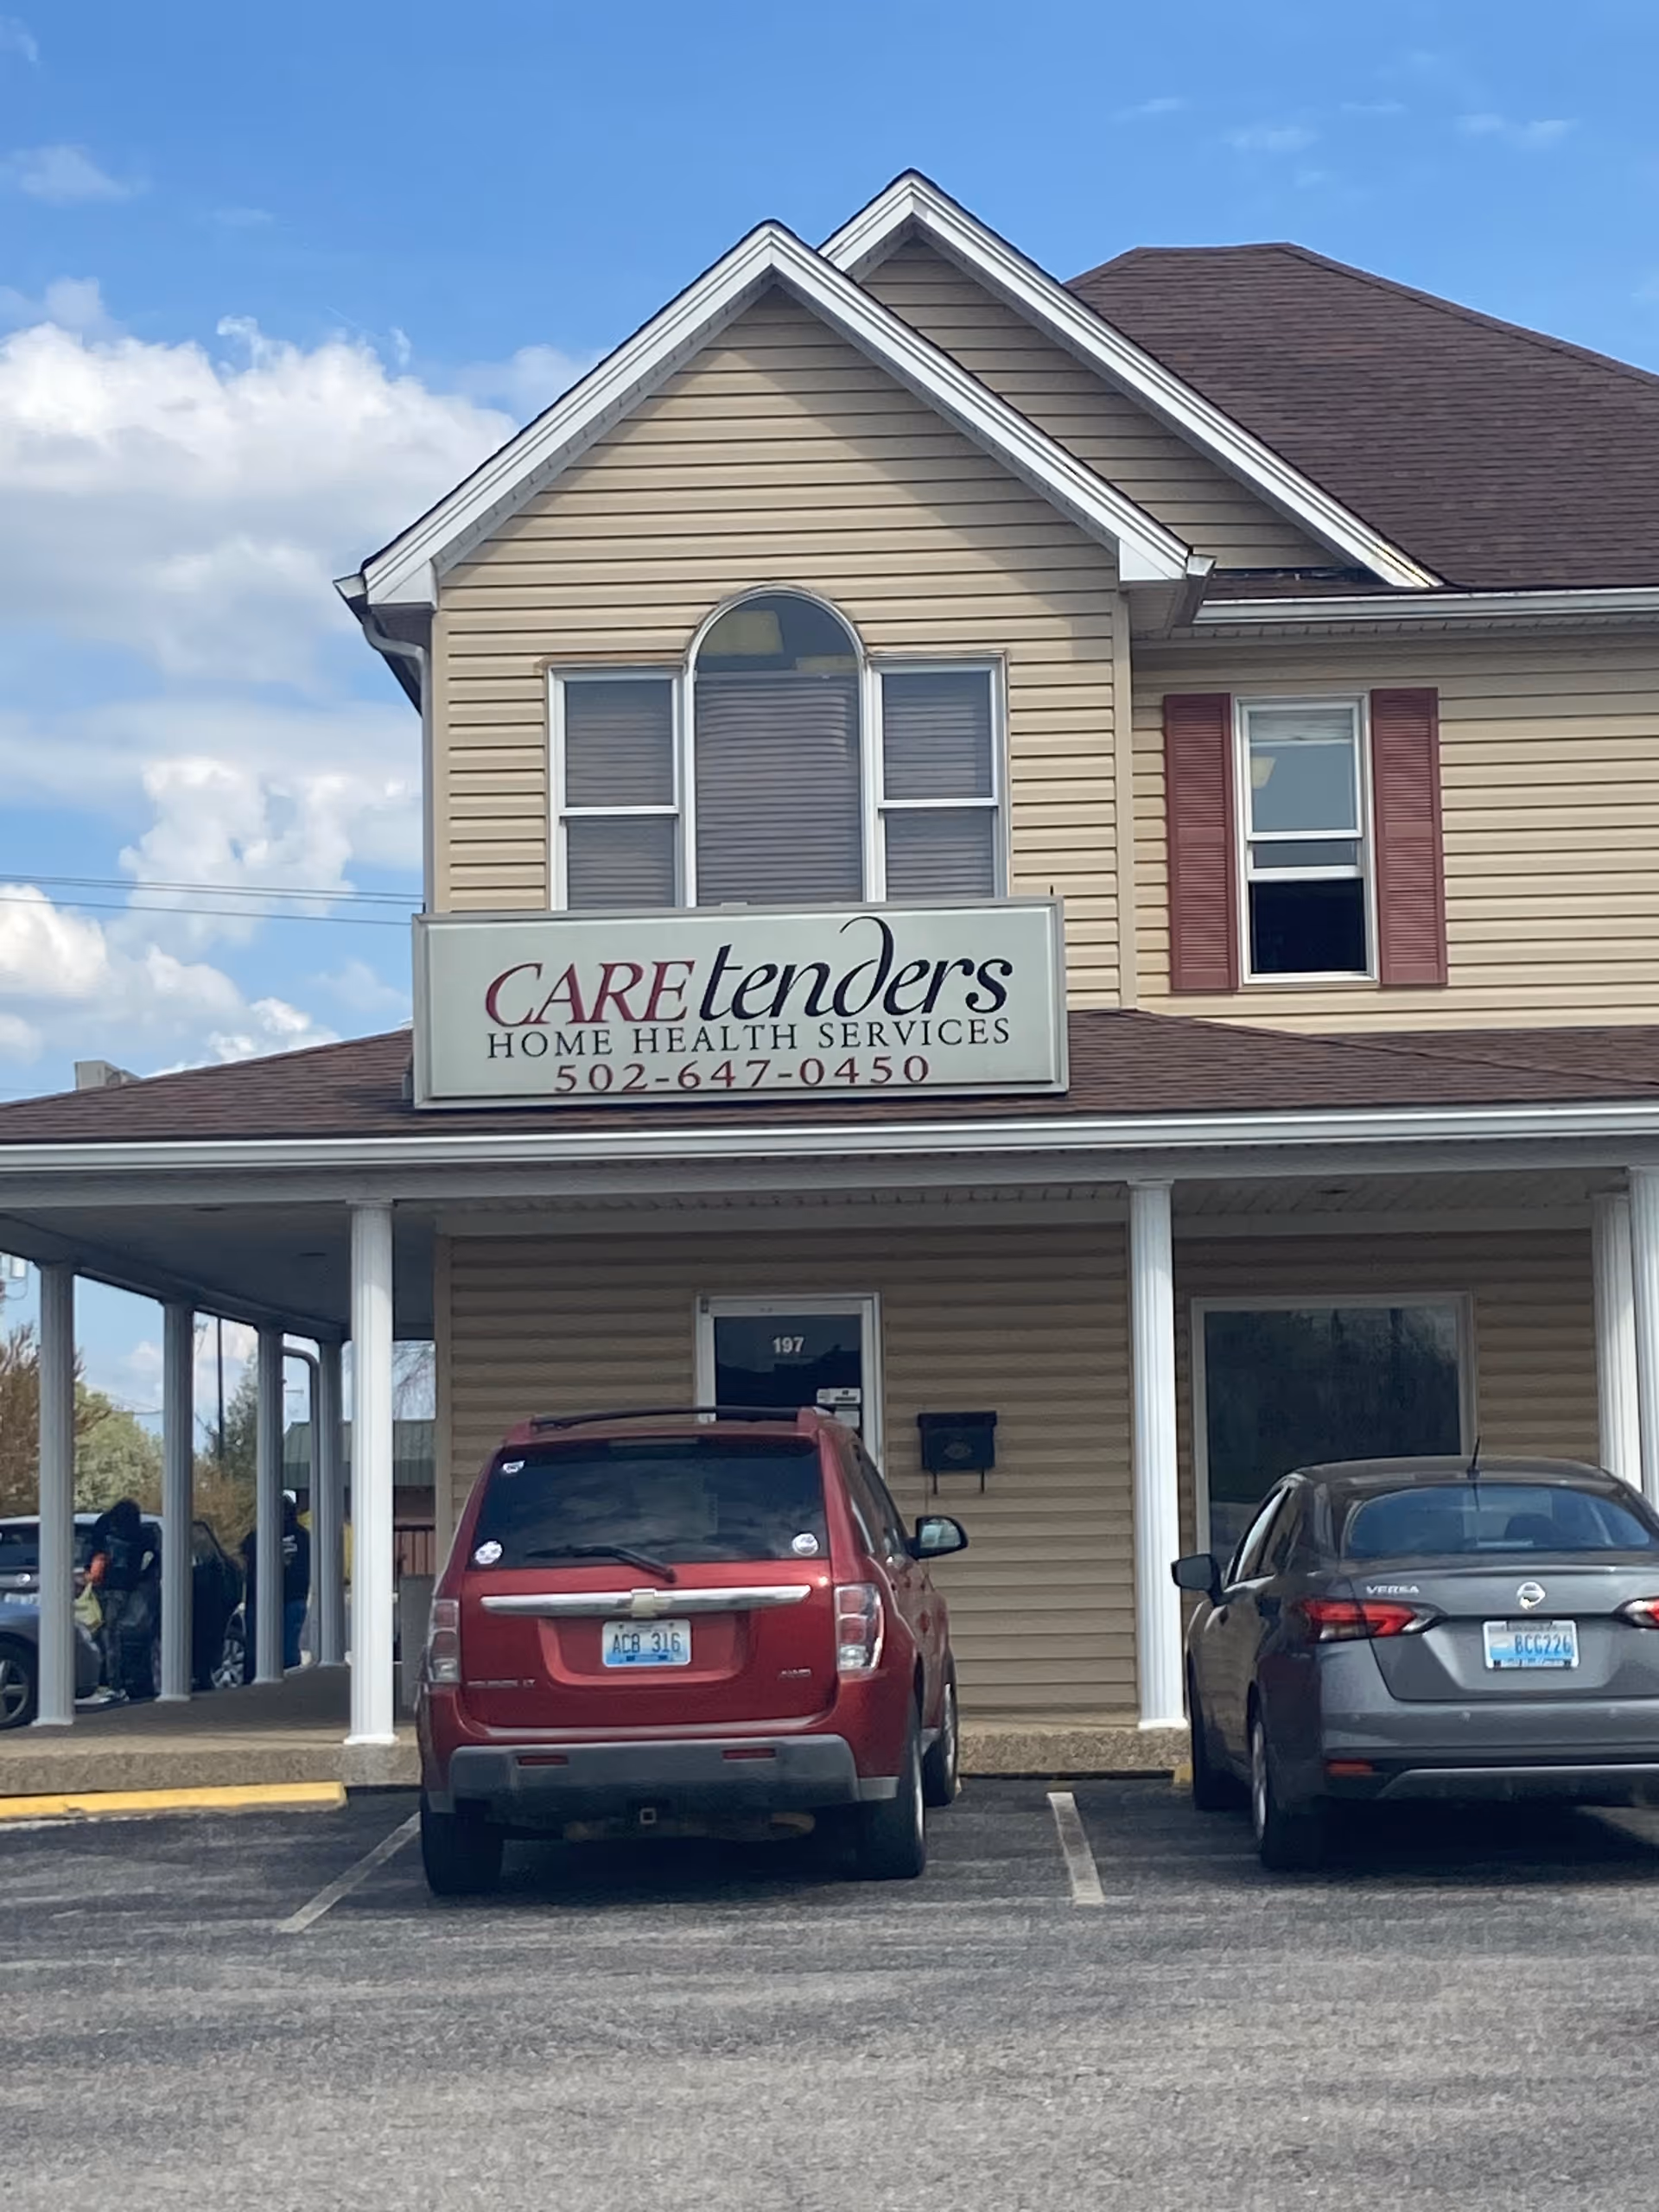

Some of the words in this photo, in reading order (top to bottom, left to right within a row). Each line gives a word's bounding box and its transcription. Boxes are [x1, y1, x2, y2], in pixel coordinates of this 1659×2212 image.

[486, 1029, 613, 1059] HOME
[632, 1024, 798, 1055] HEALTH
[817, 1017, 1010, 1049] SERVICES
[554, 1054, 930, 1092] 502-647-0450
[773, 1336, 804, 1354] 197
[613, 1632, 640, 1654] ACB
[651, 1631, 681, 1653] 316
